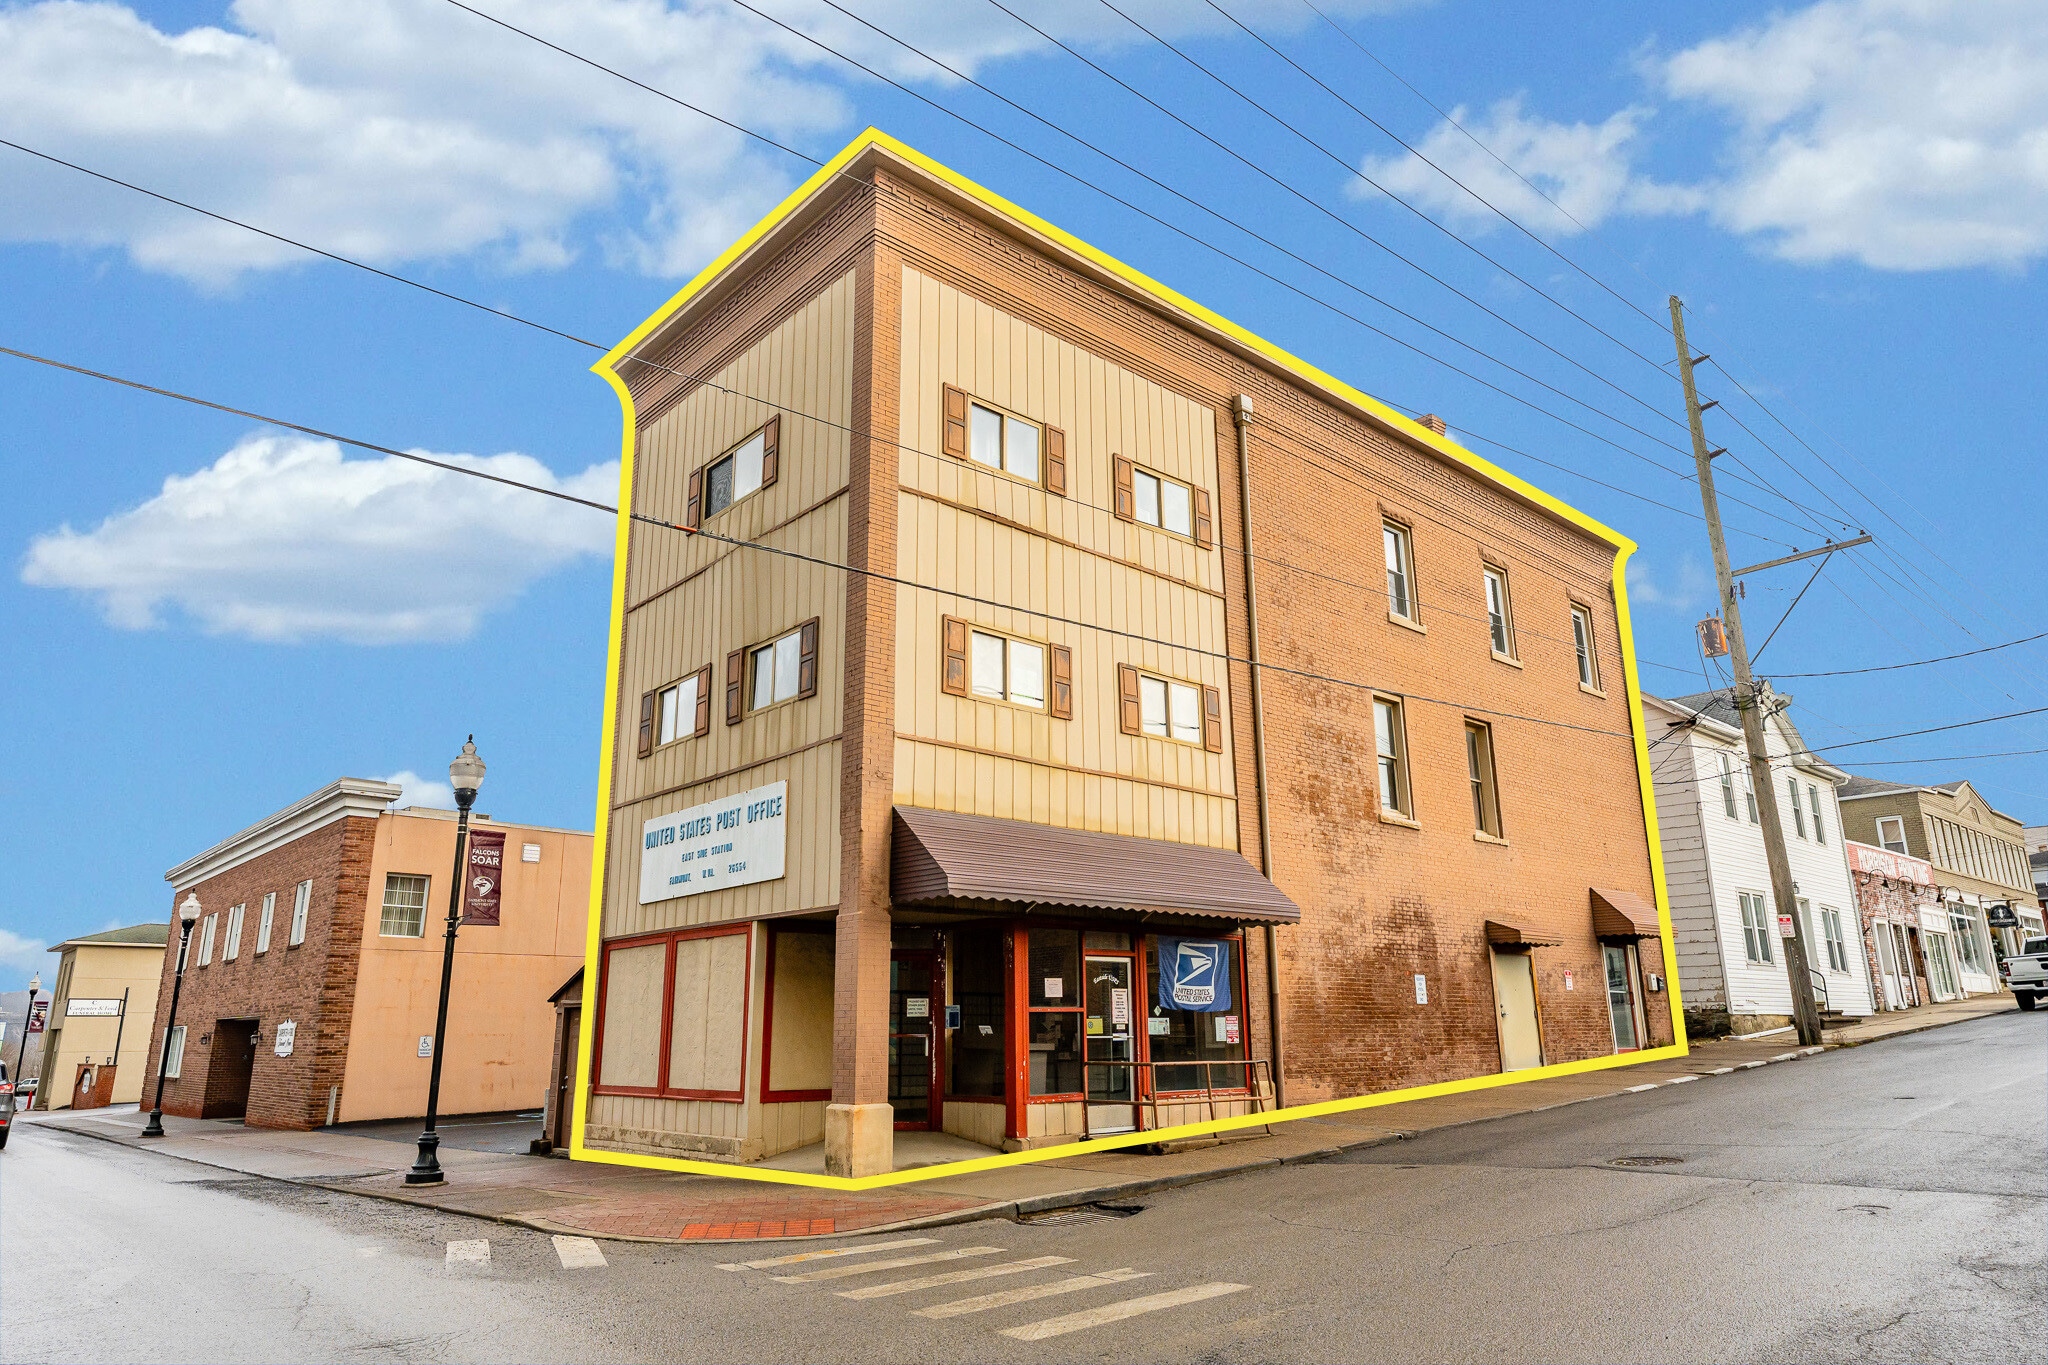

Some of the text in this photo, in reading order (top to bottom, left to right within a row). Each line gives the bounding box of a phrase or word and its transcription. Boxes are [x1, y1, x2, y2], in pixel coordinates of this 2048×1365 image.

[645, 795, 782, 849] UNITED STATES POST OFFICE
[472, 848, 500, 856] FALCONS
[681, 851, 694, 862] EAST
[711, 842, 733, 855] STATION
[471, 855, 499, 866] SOAR
[1175, 987, 1210, 996] UNITED STATES
[1175, 993, 1213, 1003] POSTAL SERVICE
